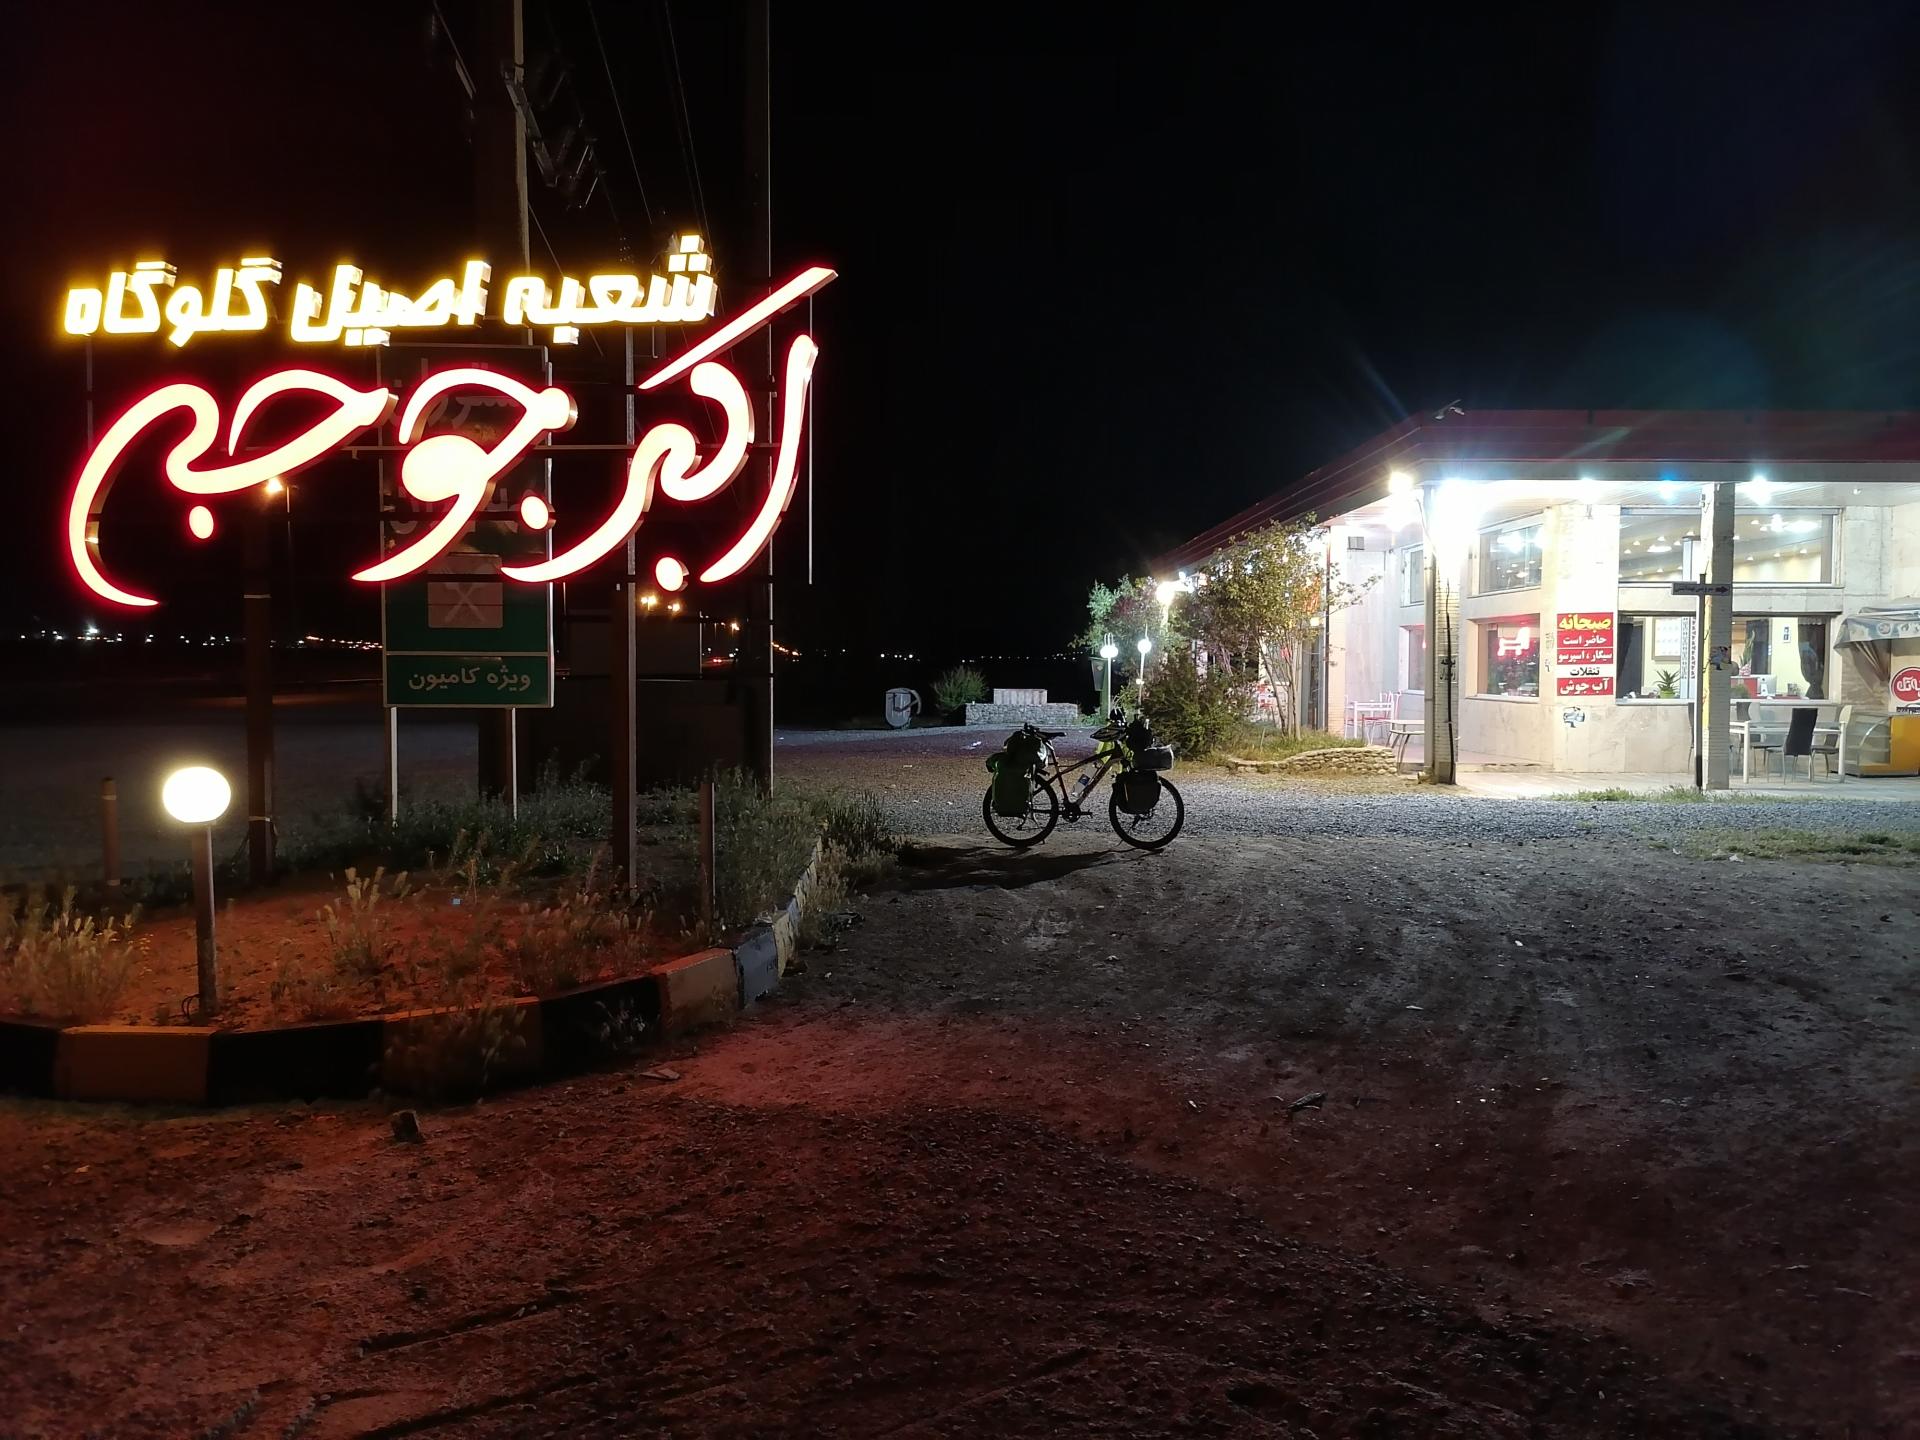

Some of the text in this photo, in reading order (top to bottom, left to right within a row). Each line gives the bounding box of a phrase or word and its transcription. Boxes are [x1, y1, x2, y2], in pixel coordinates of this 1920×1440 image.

[502, 234, 719, 345] شعبه
[64, 257, 283, 348] گلوگاه
[68, 266, 840, 608] اکبر جوجه
[1559, 613, 1611, 633] صبحانه
[1562, 634, 1607, 647] حاضر است
[408, 664, 531, 691] ویژه کامیون
[1569, 666, 1600, 676] تنقلات
[1560, 677, 1609, 695] آب جوش
